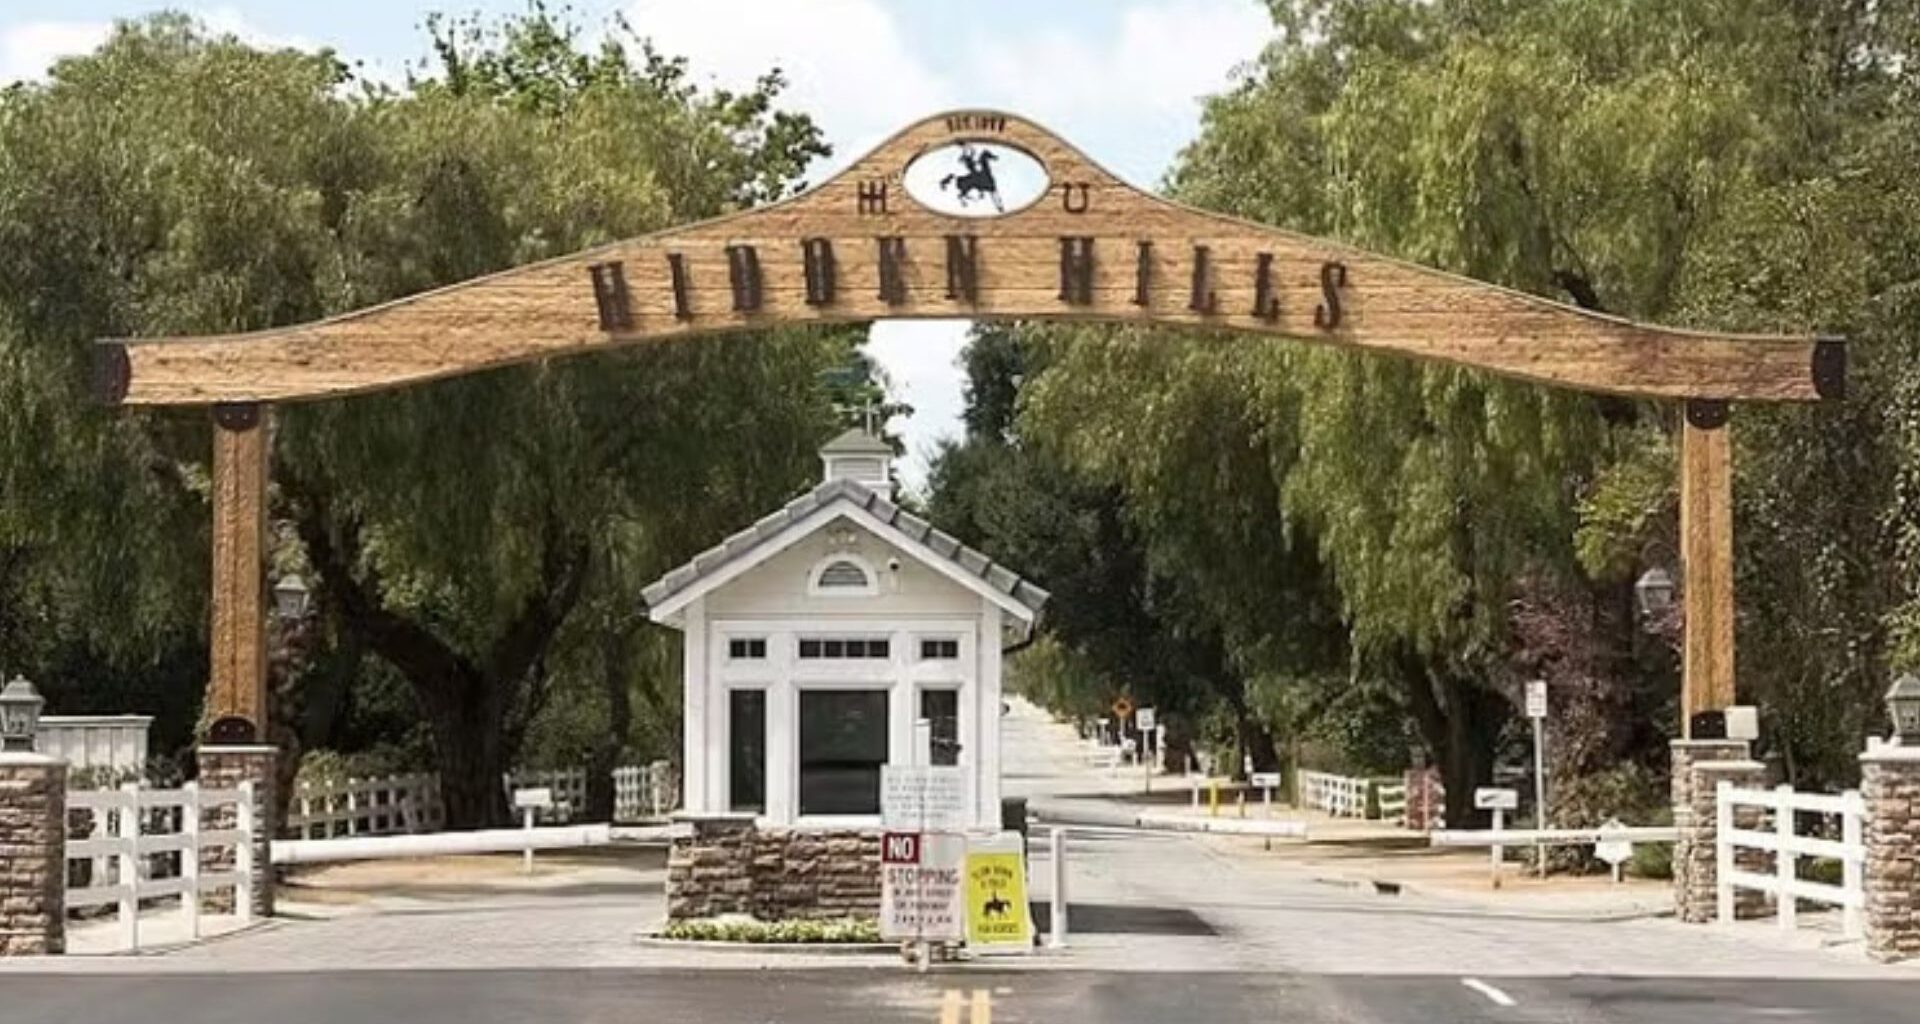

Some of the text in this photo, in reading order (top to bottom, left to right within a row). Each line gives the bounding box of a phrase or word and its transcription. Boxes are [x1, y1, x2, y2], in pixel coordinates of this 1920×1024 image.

[588, 235, 1347, 331] HIDDEN HILLS
[888, 837, 914, 859] NO
[887, 867, 959, 884] STOPPING
